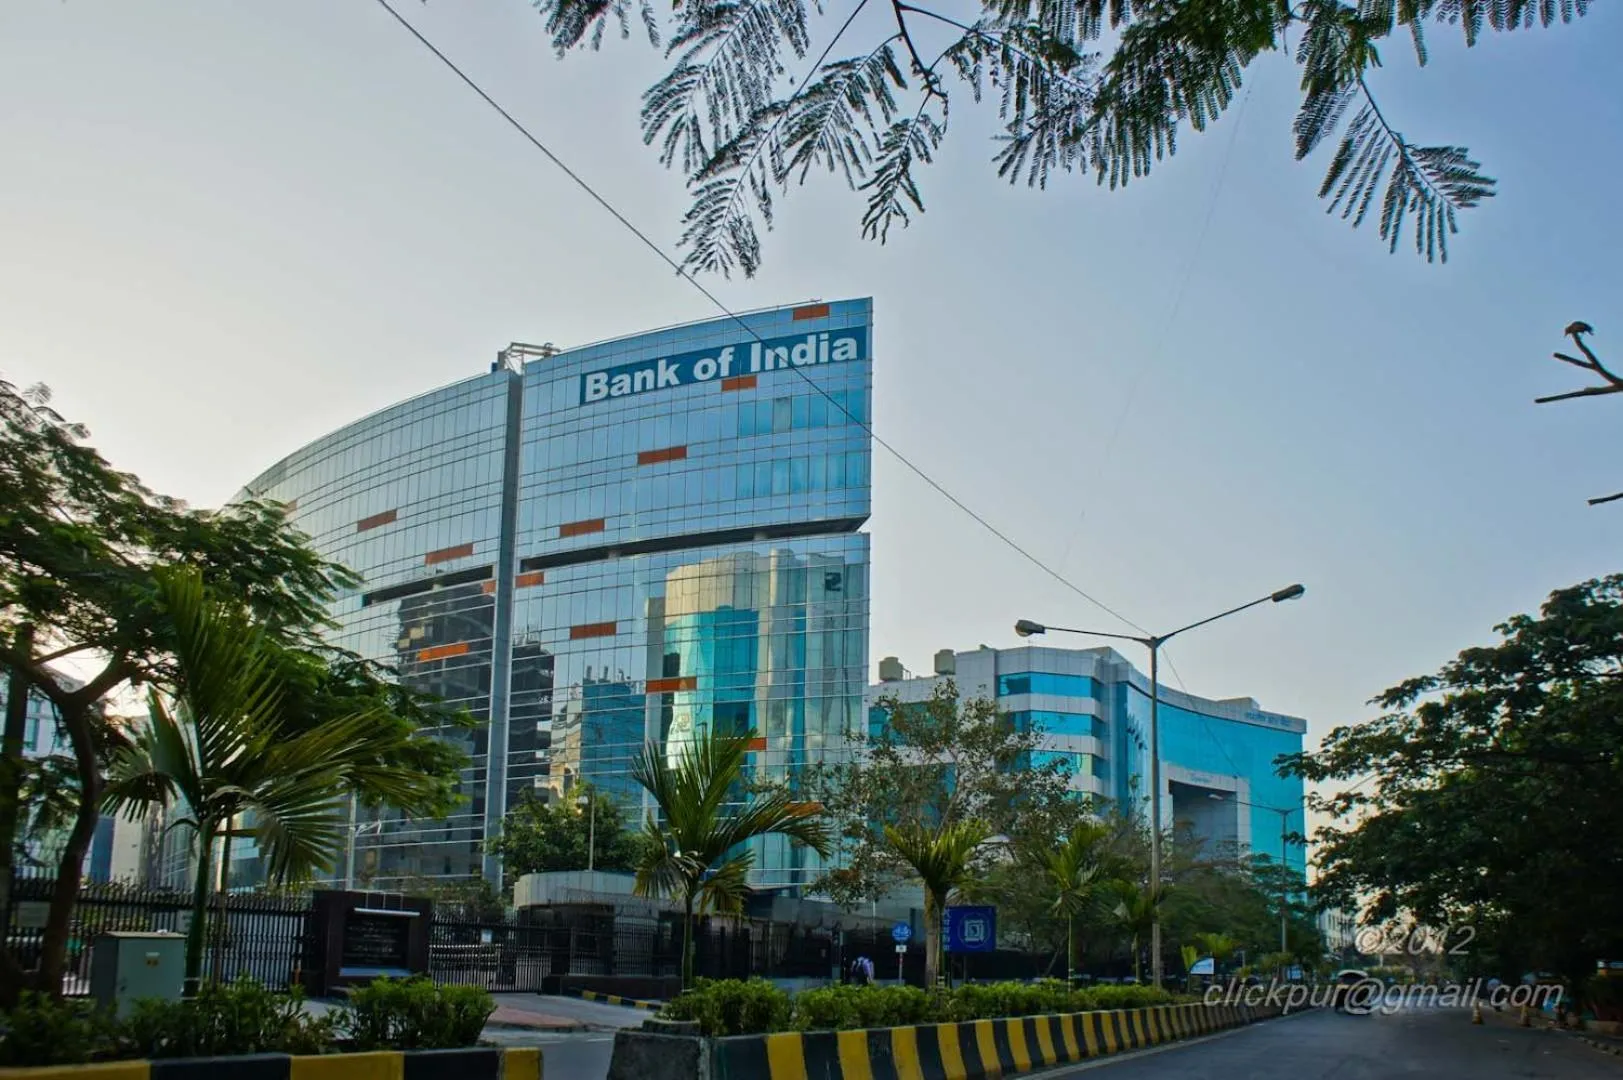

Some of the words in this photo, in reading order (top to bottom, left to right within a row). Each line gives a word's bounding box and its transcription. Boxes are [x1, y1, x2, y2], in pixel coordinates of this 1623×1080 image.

[584, 359, 680, 403] Bank
[693, 346, 736, 379] of
[750, 334, 858, 373] India
